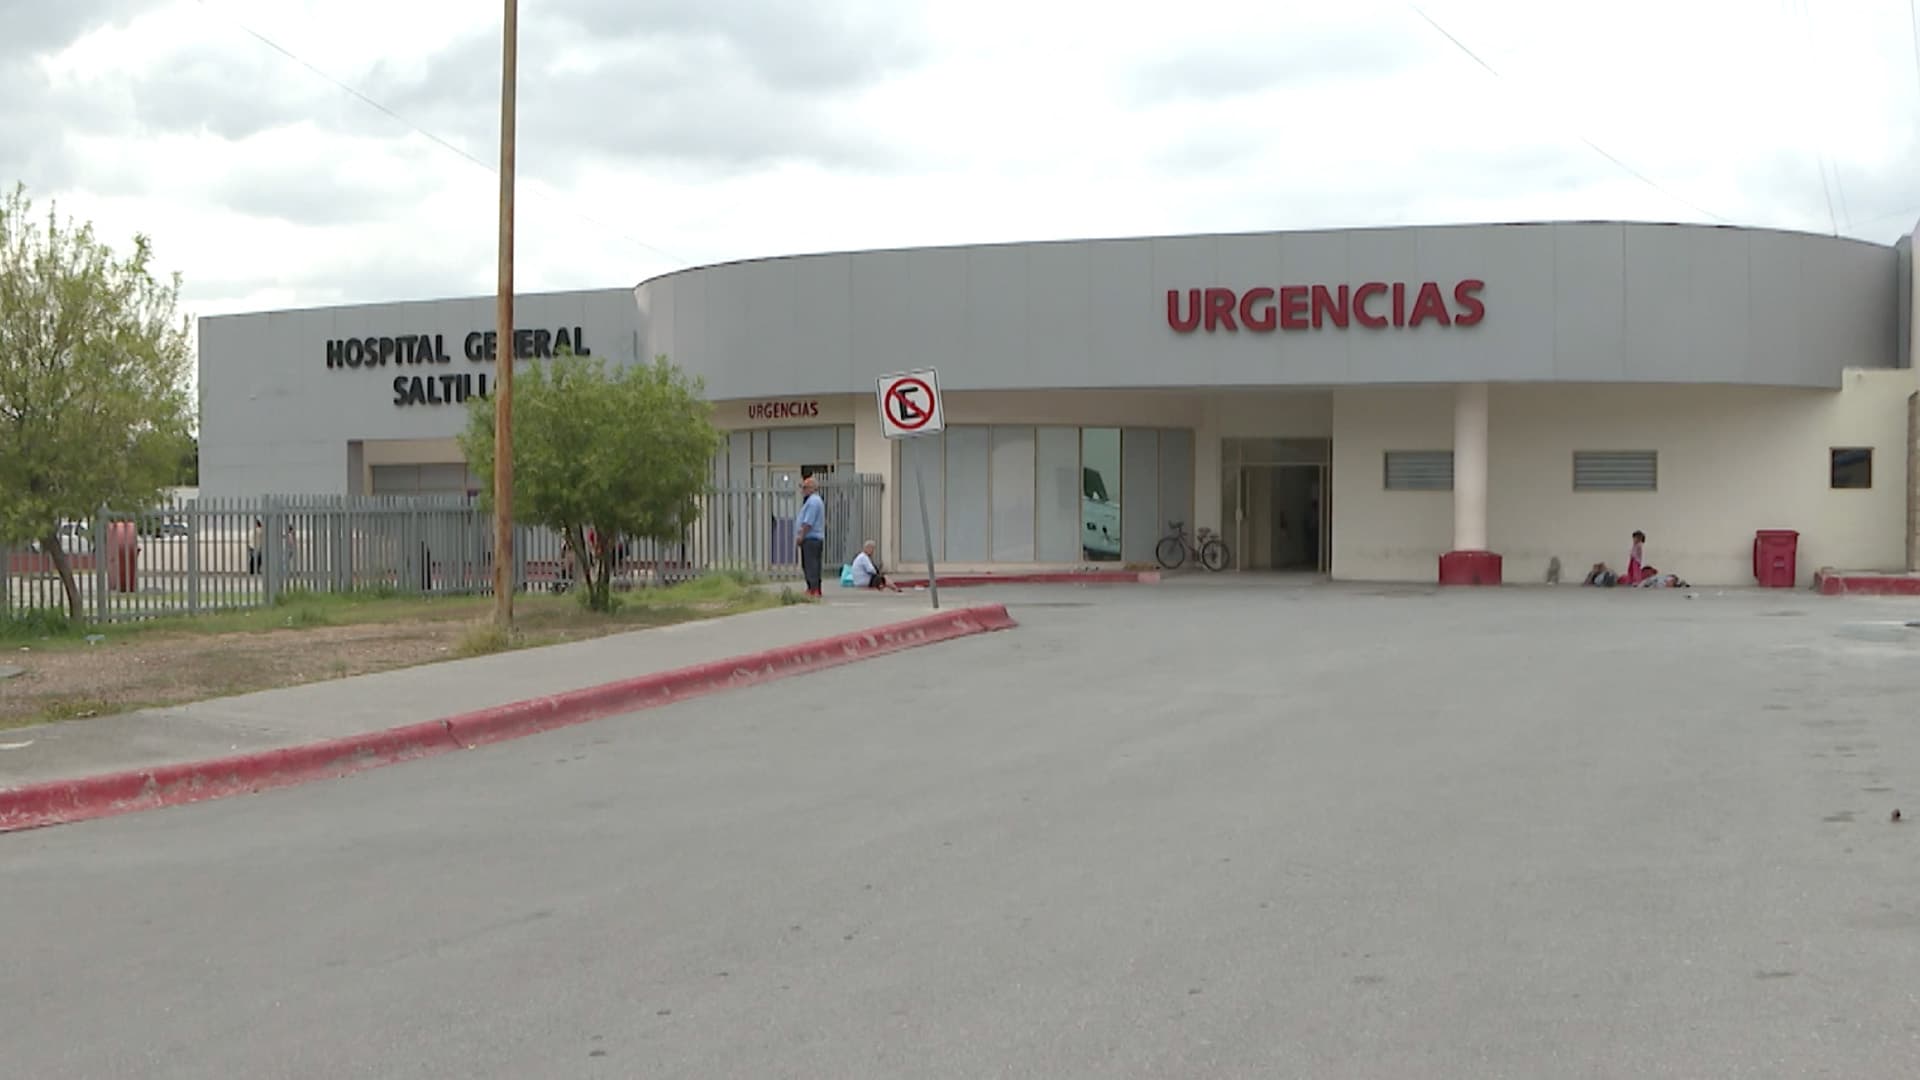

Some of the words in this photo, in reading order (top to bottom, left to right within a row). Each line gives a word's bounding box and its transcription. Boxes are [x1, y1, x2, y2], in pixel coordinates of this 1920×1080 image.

[1167, 280, 1486, 332] URGENCIAS
[326, 335, 450, 368] HOSPITAL
[464, 327, 590, 361] GEERAL
[393, 373, 497, 406] SALTILL
[748, 401, 819, 419] URGENCIAS
